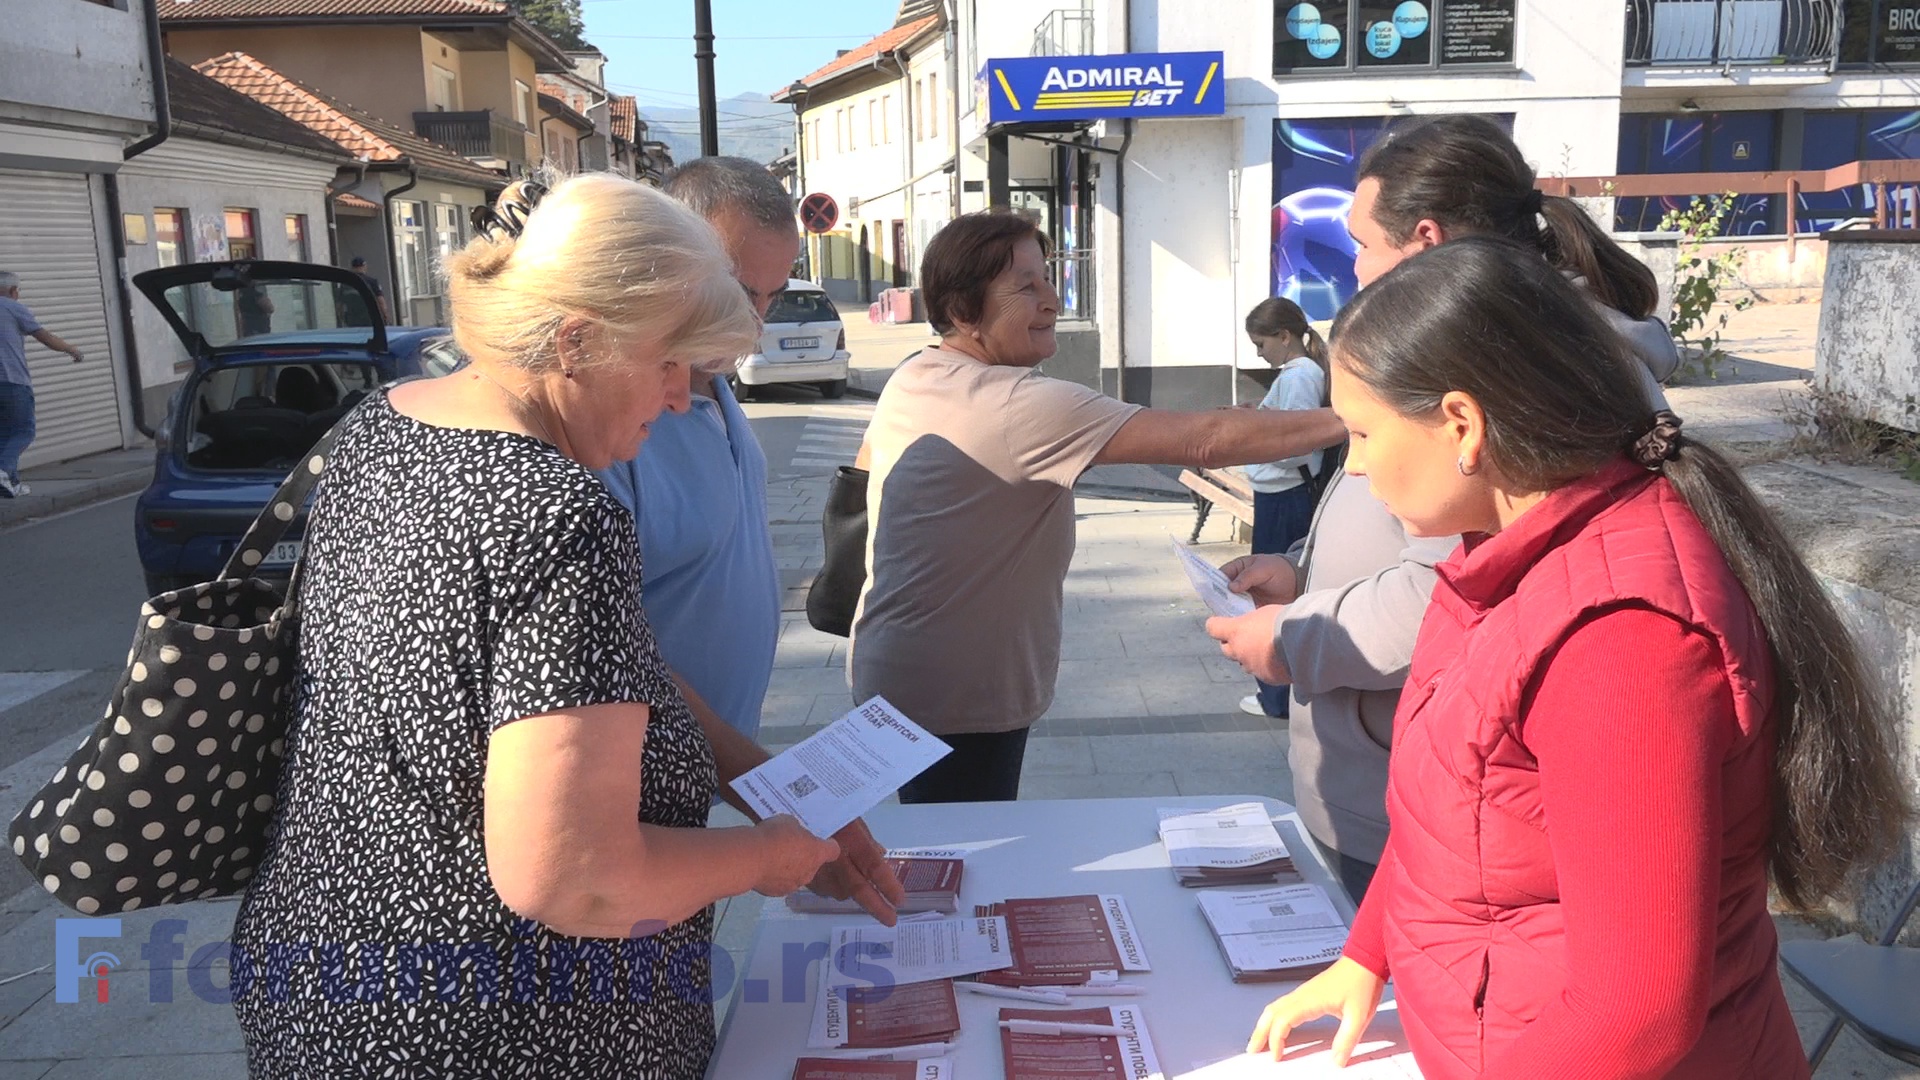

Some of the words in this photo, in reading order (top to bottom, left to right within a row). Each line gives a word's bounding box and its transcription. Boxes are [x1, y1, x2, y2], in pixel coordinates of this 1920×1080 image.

[1309, 37, 1339, 45] Izdajem
[1042, 64, 1183, 90] ADMIRAL
[1133, 89, 1183, 107] BET
[860, 709, 885, 729] ПЛАН
[869, 703, 920, 743] СТУДЕНТСКИ
